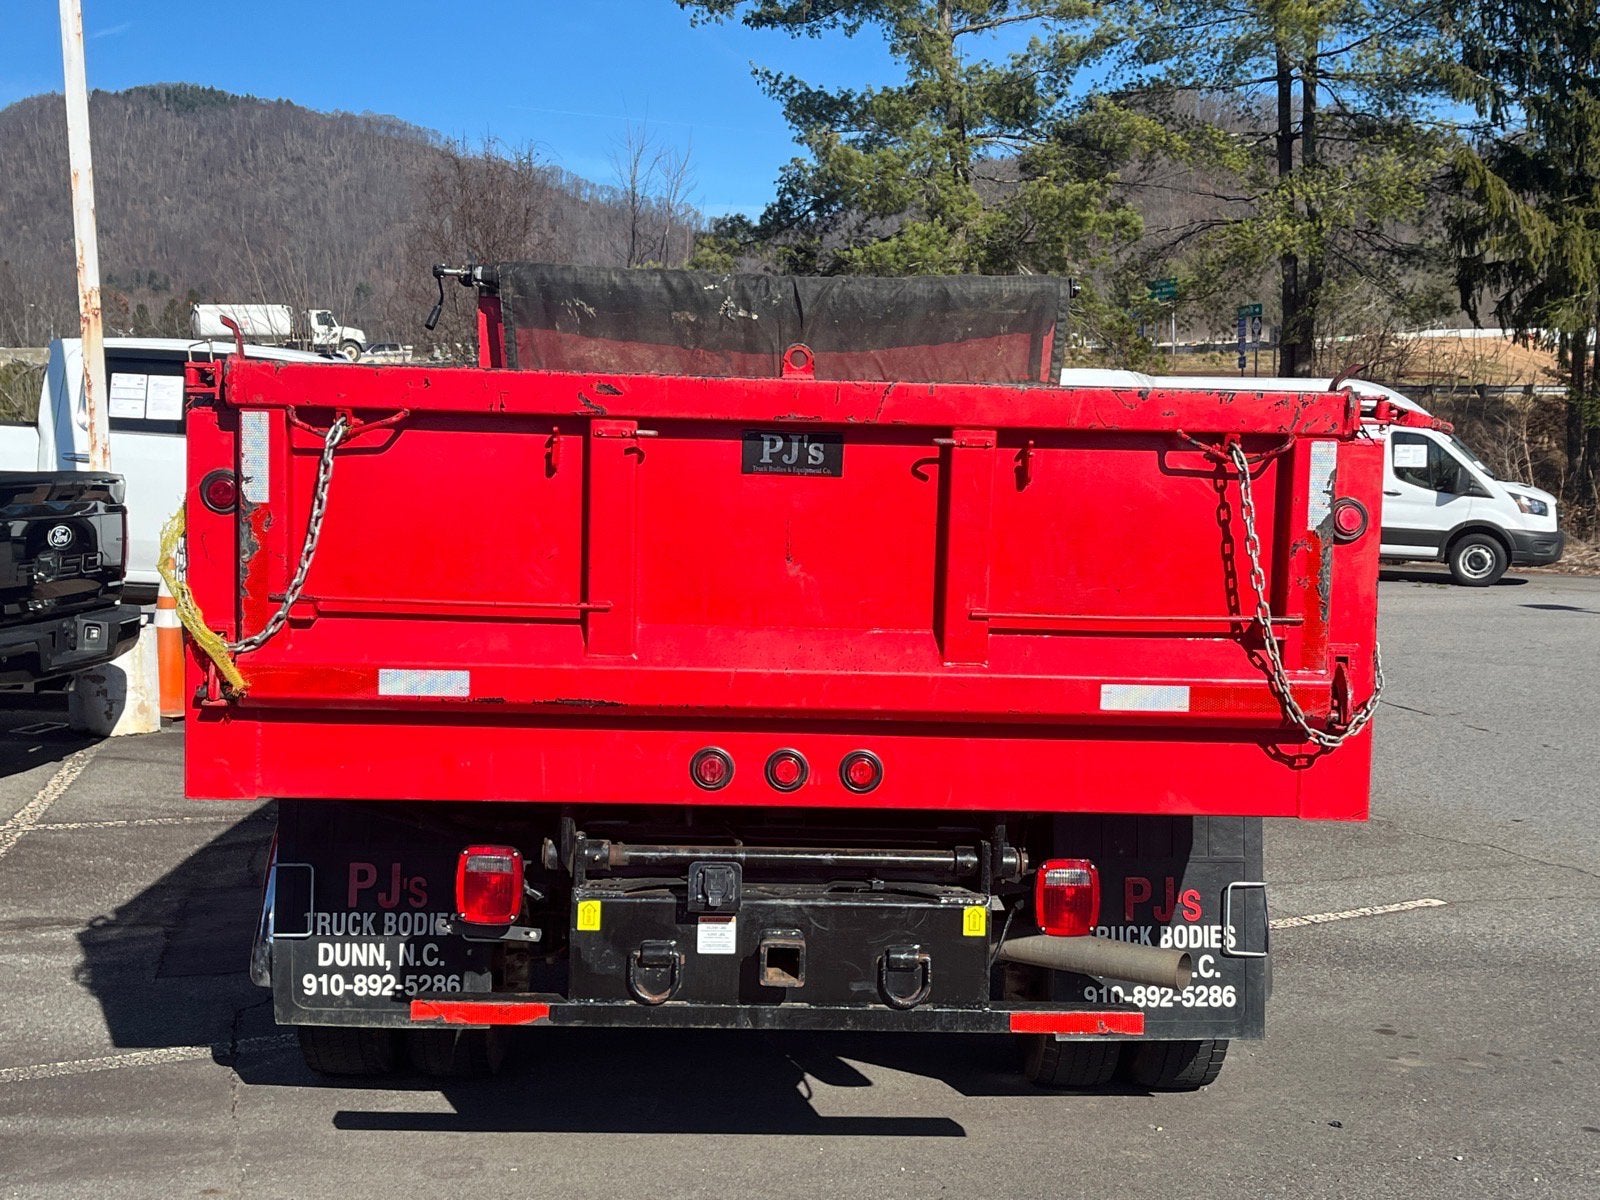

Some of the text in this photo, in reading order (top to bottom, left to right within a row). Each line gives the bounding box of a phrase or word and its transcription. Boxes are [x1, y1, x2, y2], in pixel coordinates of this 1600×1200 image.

[760, 433, 825, 465] PJ's
[347, 862, 428, 909] PJ's
[1096, 925, 1237, 949] RUCK BODIES
[317, 942, 446, 970] DUNN, N.C.
[1191, 954, 1221, 978] .C.
[302, 973, 461, 997] 910-892-5286
[1083, 984, 1237, 1008] 910-892-5286
